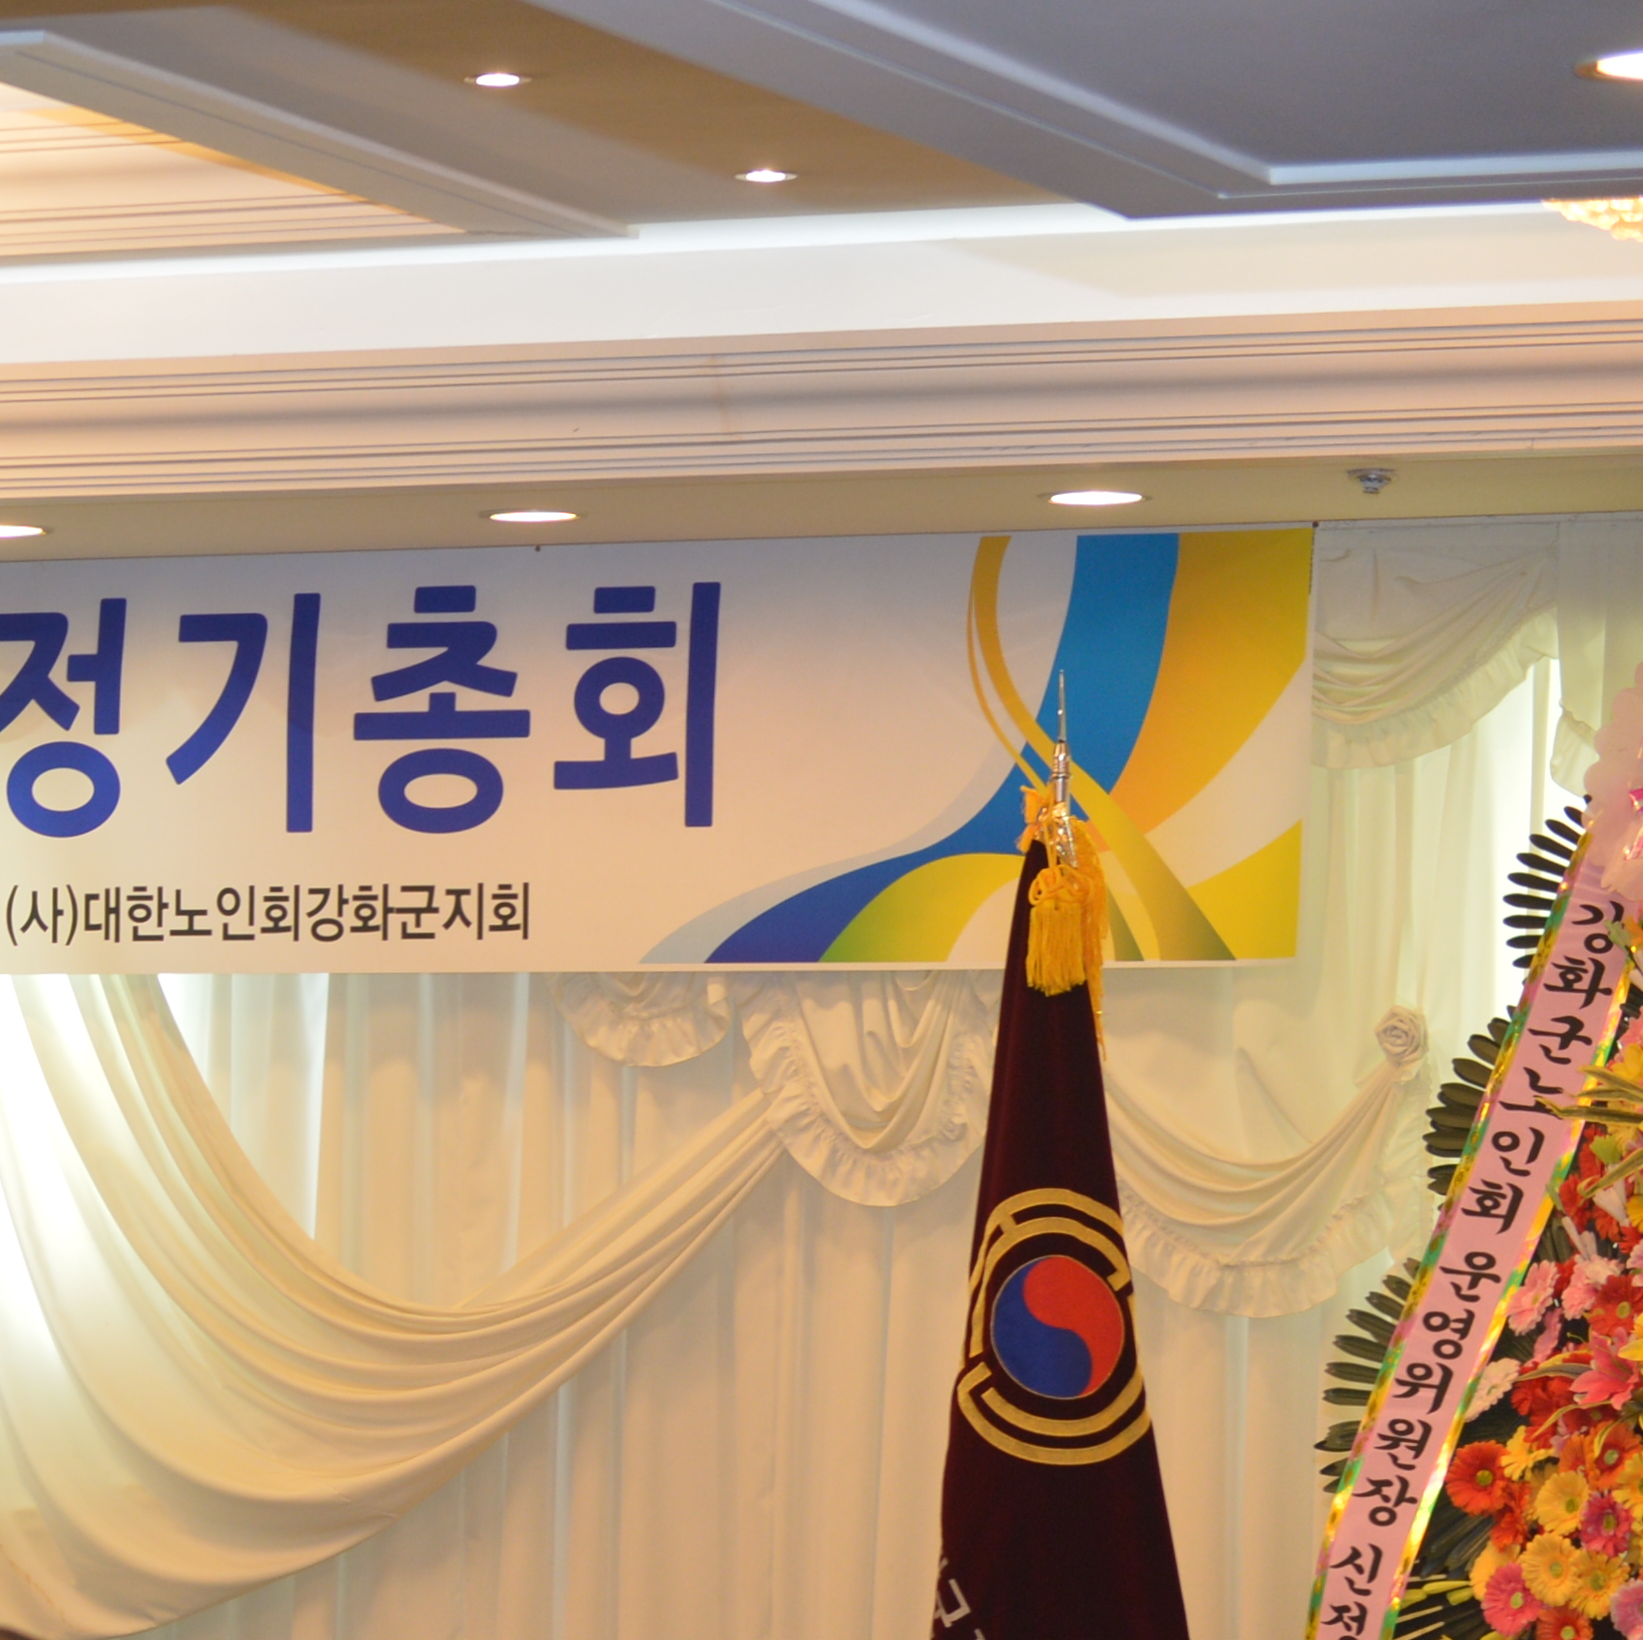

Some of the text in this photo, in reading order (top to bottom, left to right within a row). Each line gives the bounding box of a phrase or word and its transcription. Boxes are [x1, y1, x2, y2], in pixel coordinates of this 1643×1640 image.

[5, 881, 531, 948] (사)대한노인회강화군지회
[1460, 899, 1625, 1236] 강화군노인회
[1352, 1250, 1502, 1527] 운영위원장
